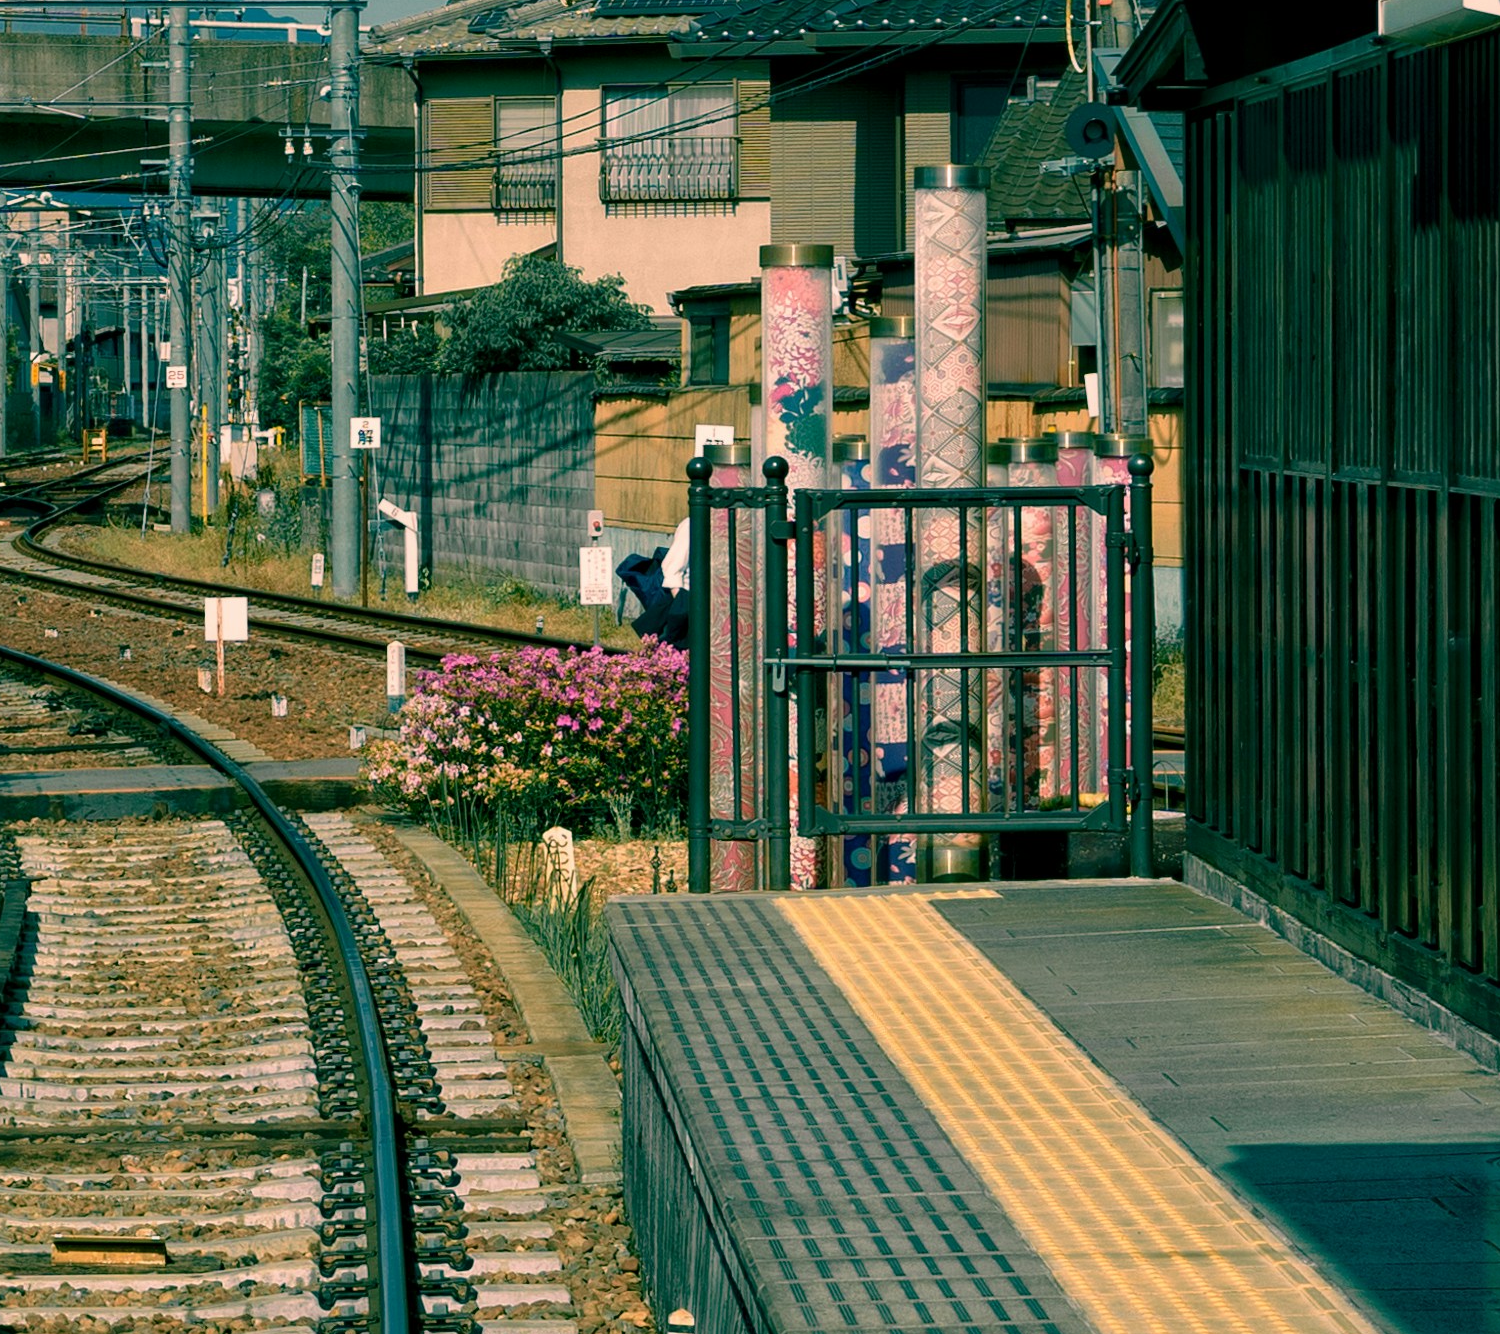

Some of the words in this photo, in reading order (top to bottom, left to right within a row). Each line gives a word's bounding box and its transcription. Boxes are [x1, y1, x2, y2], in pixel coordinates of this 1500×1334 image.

[167, 369, 185, 381] 25
[361, 420, 370, 430] 2
[357, 429, 374, 446] 解
